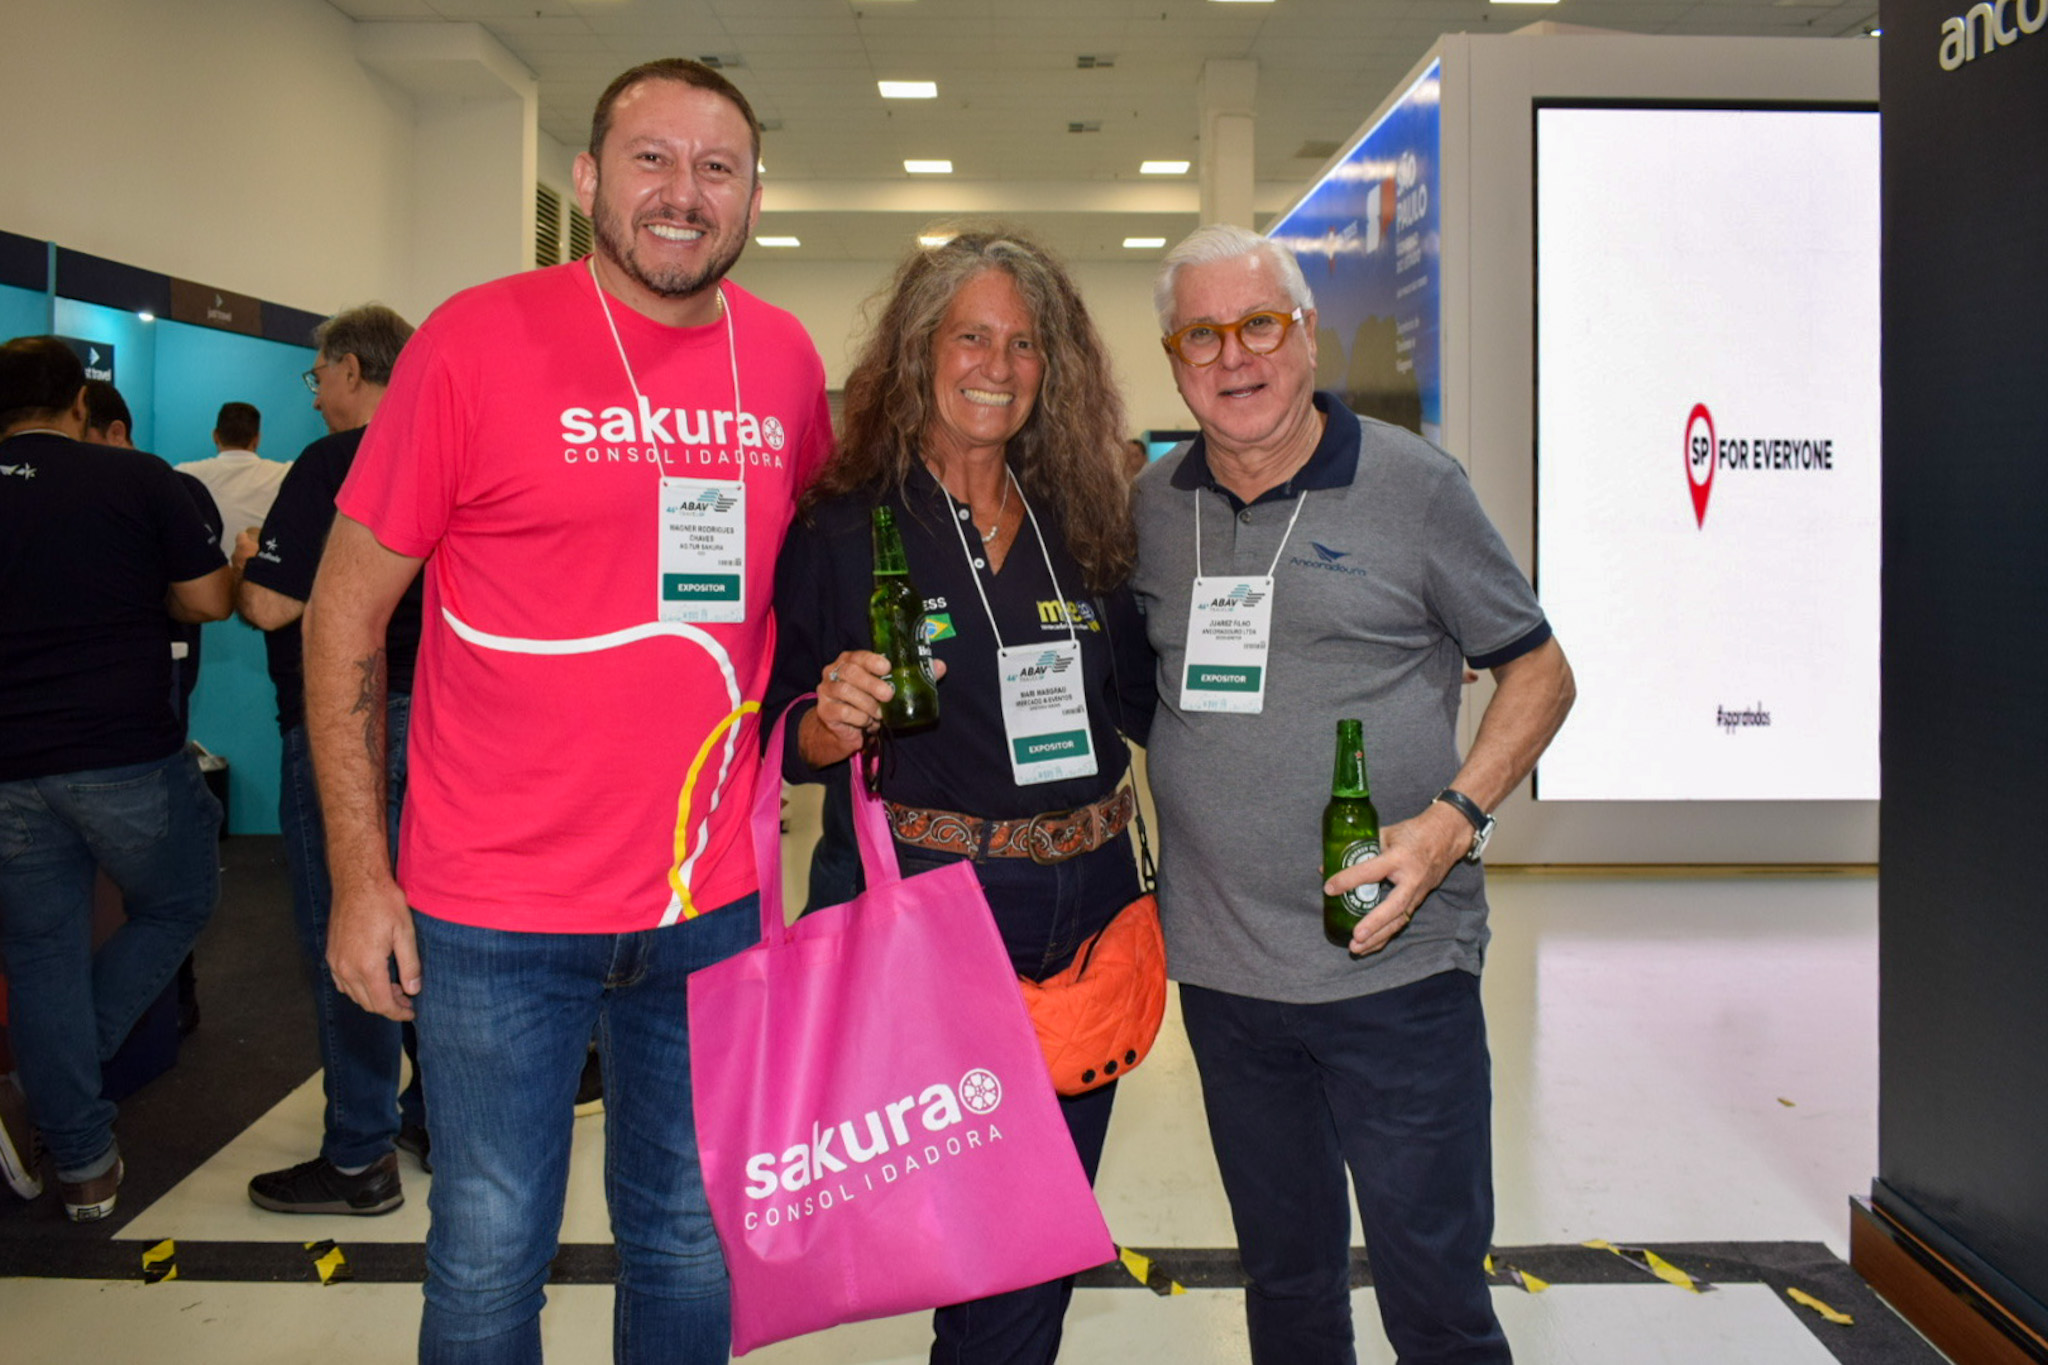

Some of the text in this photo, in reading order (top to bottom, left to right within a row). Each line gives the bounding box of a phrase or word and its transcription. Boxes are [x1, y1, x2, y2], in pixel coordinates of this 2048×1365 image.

[560, 395, 763, 448] sakura
[564, 447, 784, 469] CONSOLIDADORA
[1692, 436, 1832, 470] SP FOR EVERYONE
[680, 501, 709, 511] ABAV
[669, 524, 735, 534] WAGNER RODRIGUES
[689, 534, 714, 542] CHAVES
[677, 583, 726, 593] EXPOSITOR
[922, 597, 947, 612] ESS
[1211, 598, 1239, 607] ABAV
[1020, 666, 1048, 676] ABAV
[1200, 674, 1247, 683] EXPOSITOR
[1029, 740, 1075, 754] EXPOSITOR
[745, 1083, 963, 1200] sakura
[744, 1124, 1003, 1231] CONSOLIDADORA
